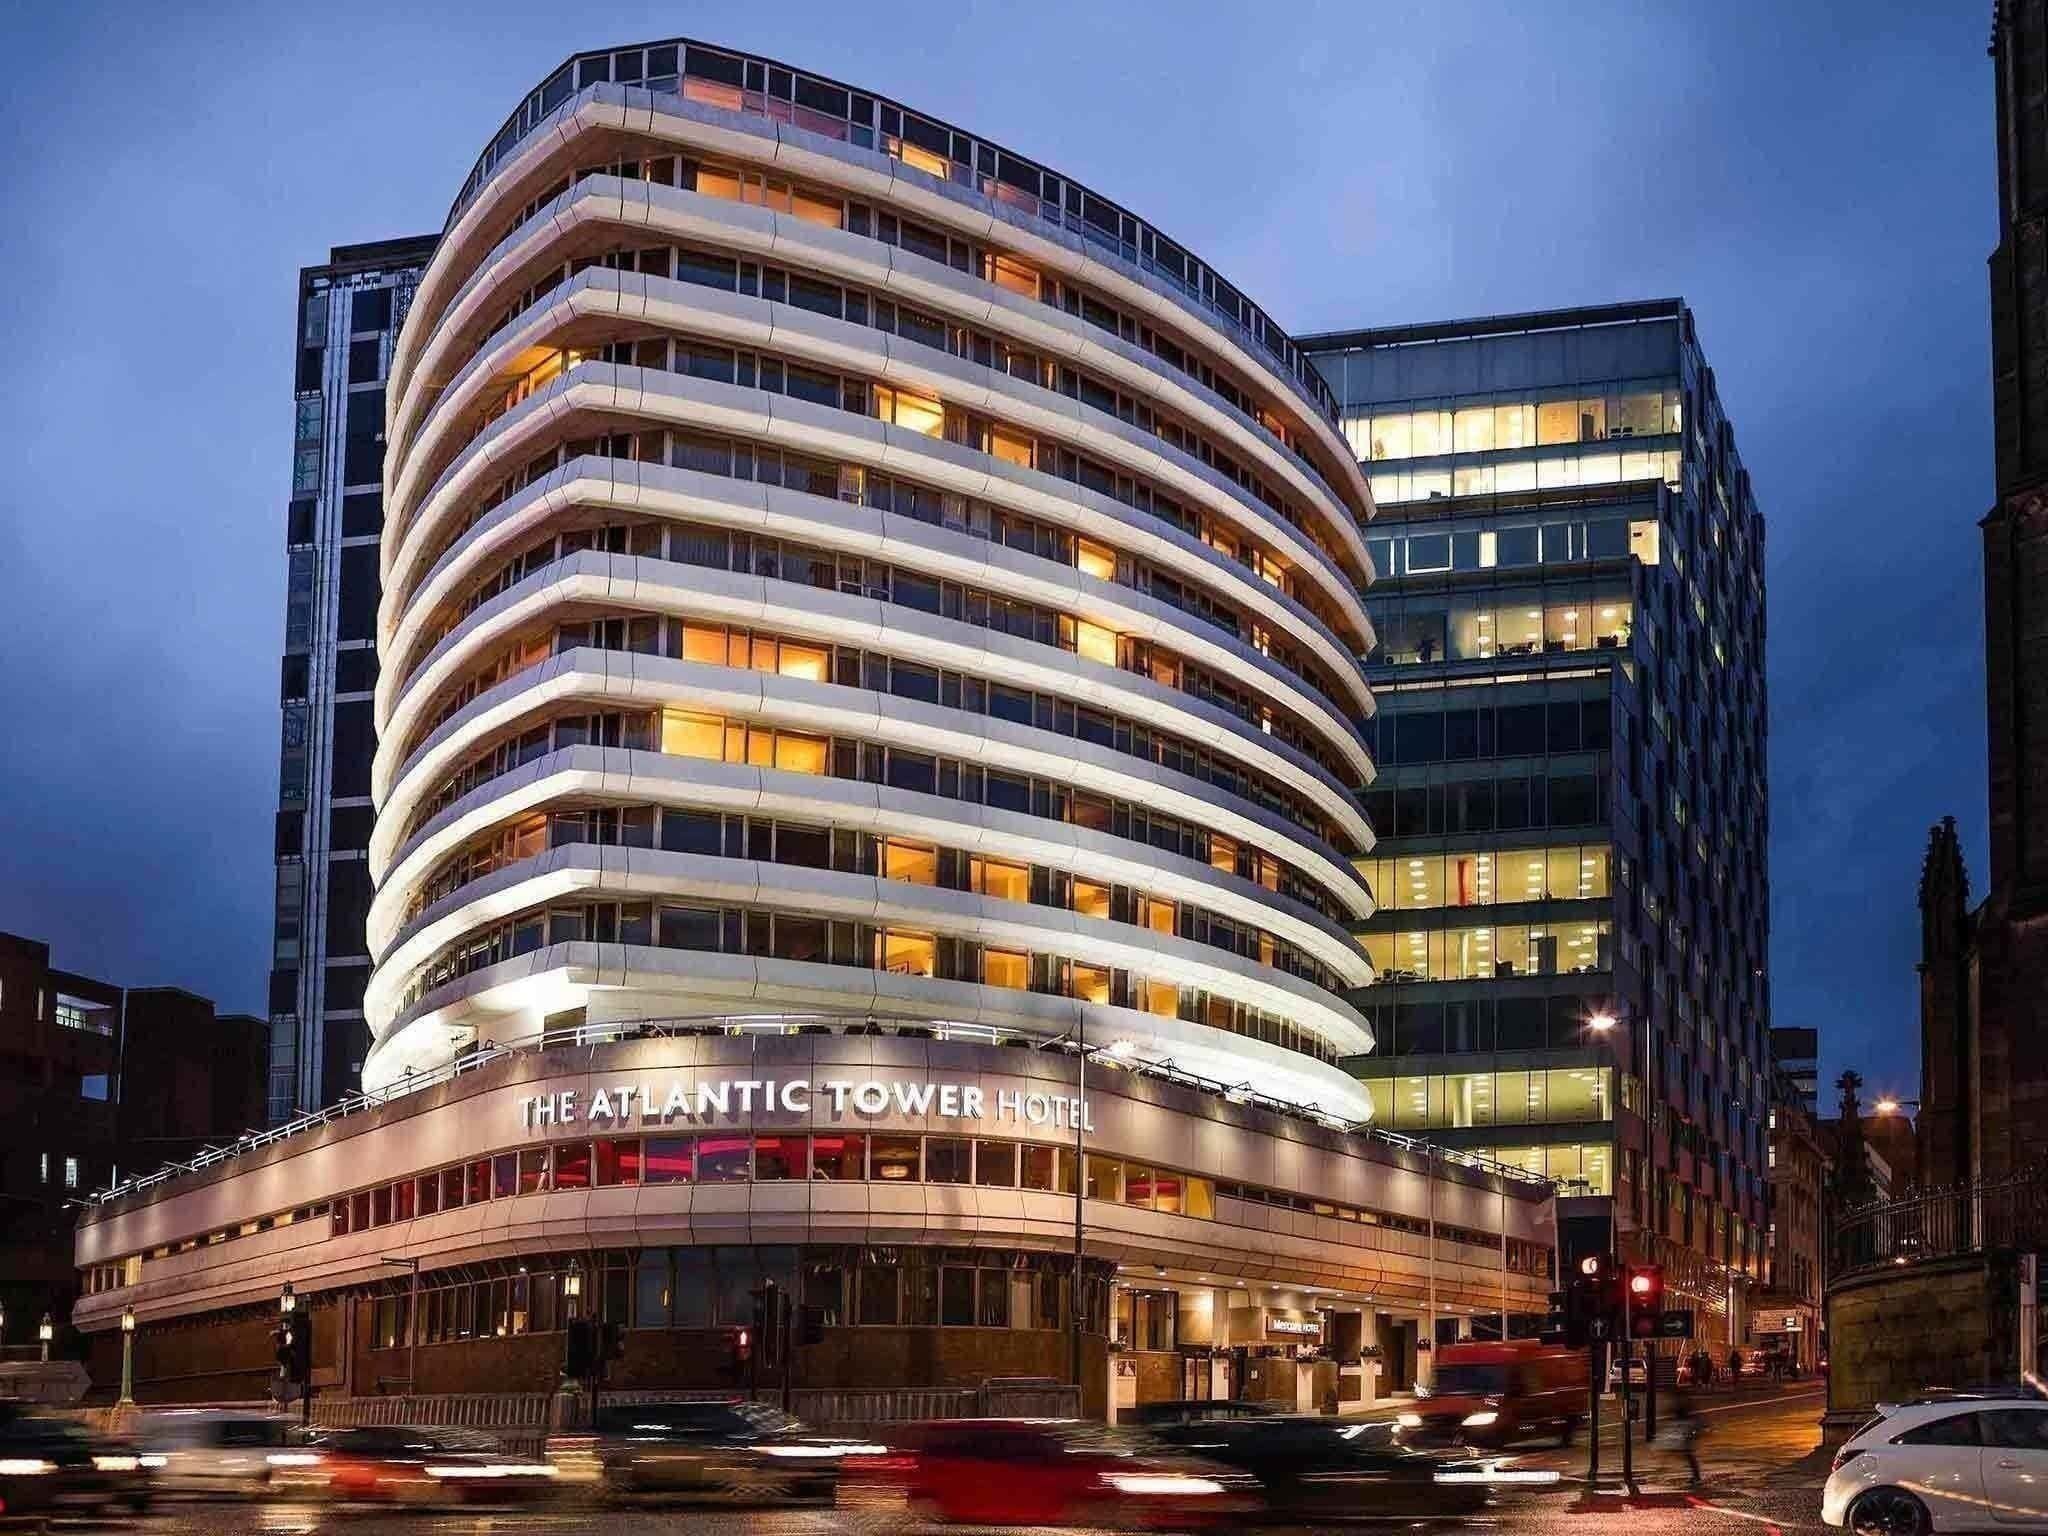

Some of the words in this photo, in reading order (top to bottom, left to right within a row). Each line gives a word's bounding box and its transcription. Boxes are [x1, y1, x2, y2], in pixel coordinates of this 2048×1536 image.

[518, 1090, 577, 1127] THE
[588, 1080, 811, 1119] ATLANTIC
[826, 1080, 984, 1119] TOWER
[998, 1088, 1095, 1132] HOTEL
